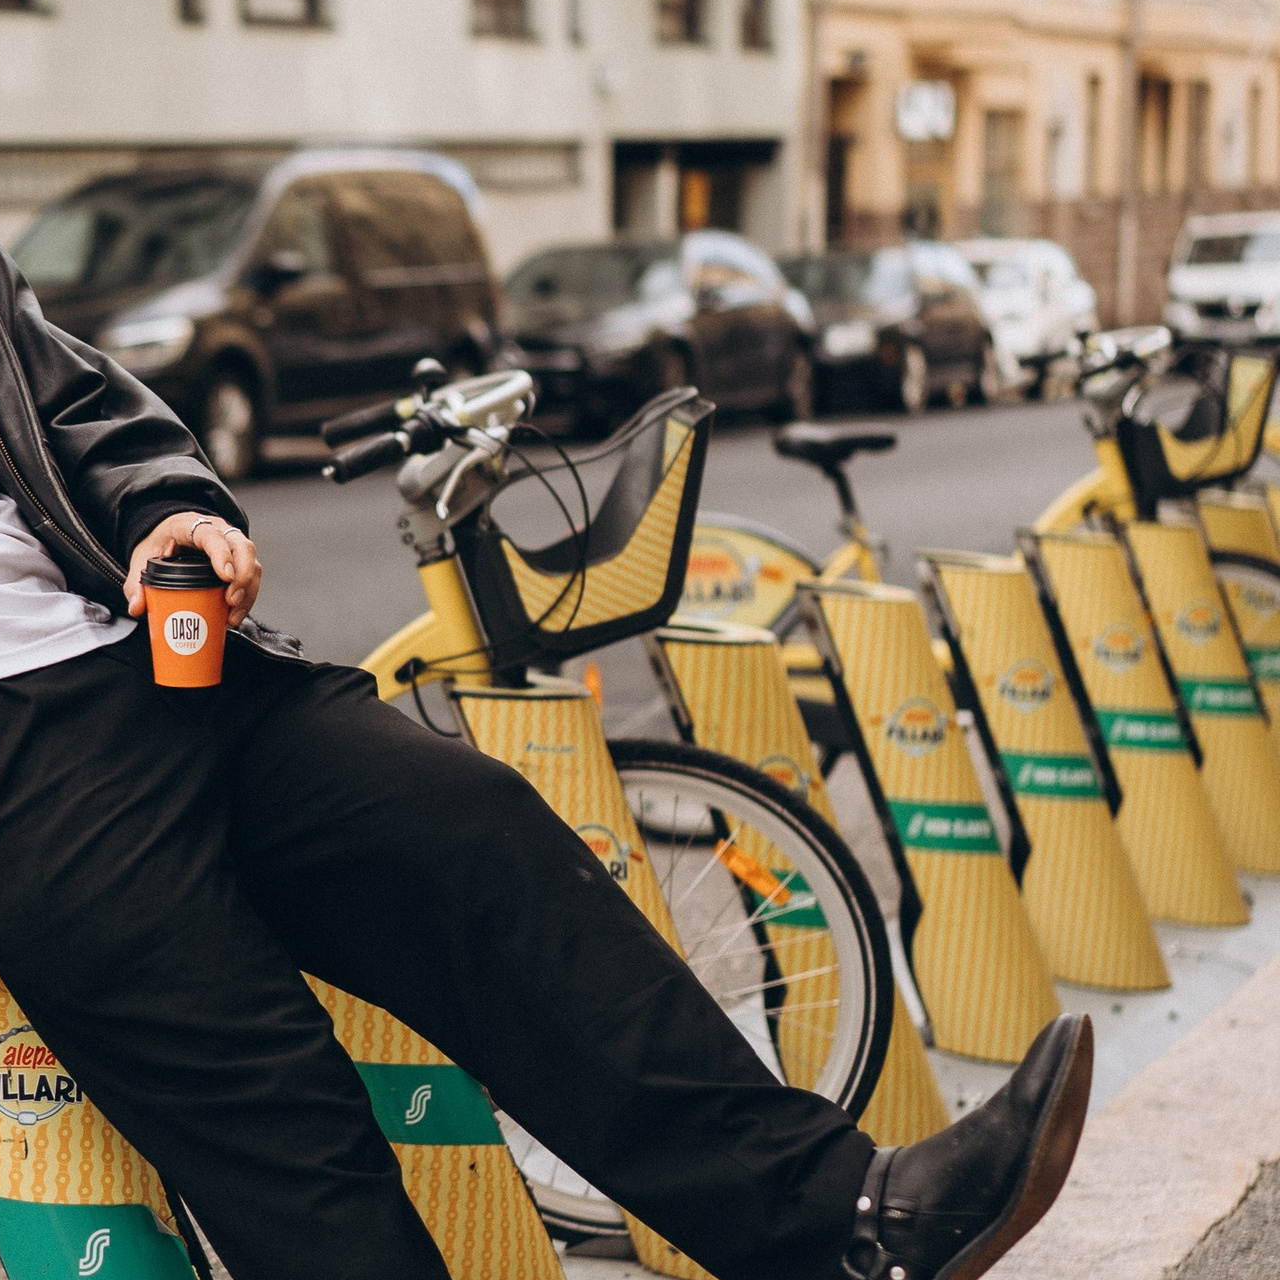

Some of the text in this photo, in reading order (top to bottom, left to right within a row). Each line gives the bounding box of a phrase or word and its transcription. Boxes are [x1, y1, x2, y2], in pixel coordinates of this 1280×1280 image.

[172, 617, 200, 640] DASH
[175, 641, 197, 649] COFFEE
[2, 1042, 56, 1069] alepa
